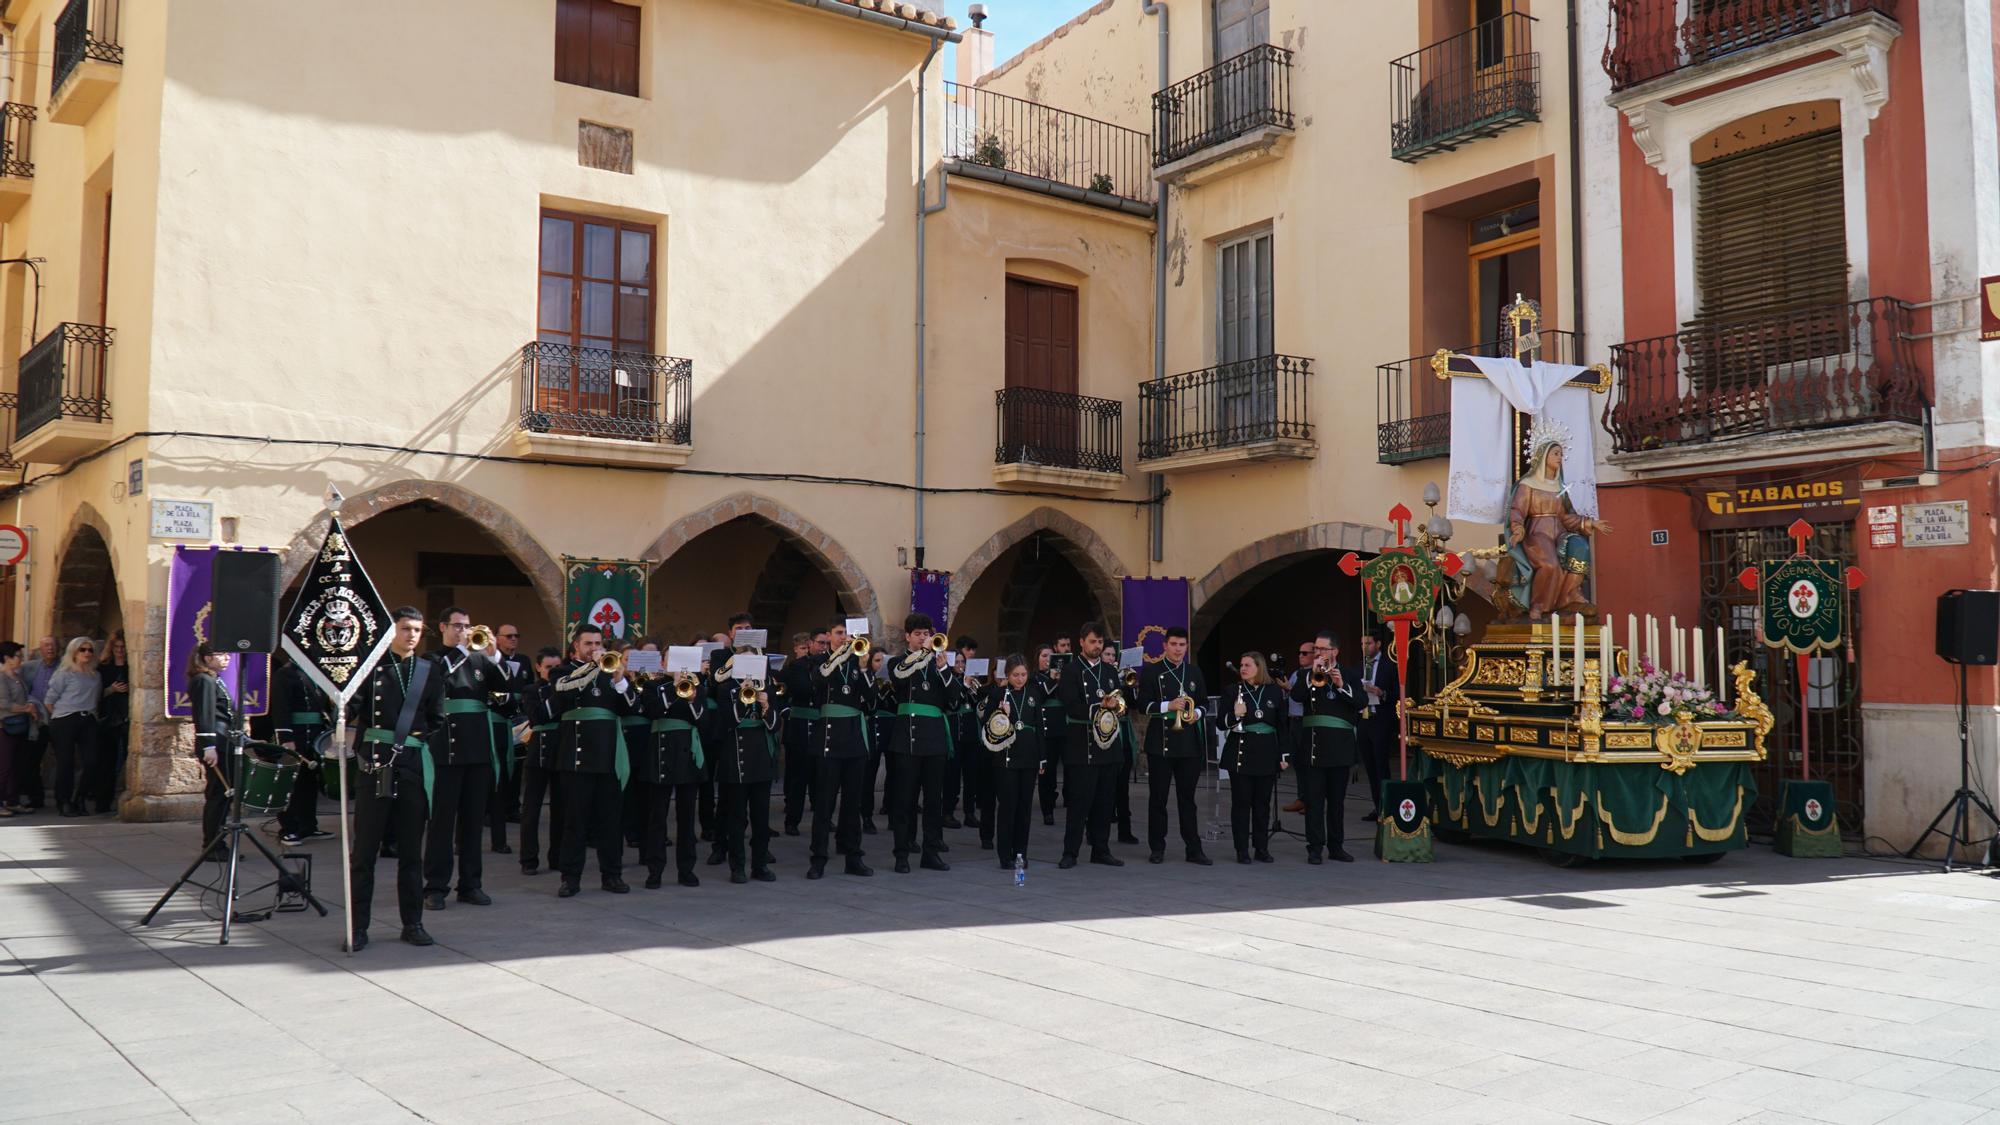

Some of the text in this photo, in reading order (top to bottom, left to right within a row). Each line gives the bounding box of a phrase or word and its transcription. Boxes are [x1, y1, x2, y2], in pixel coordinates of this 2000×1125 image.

[1737, 481, 1843, 503] TABACOS
[1655, 533, 1665, 542] 13
[1926, 533, 1935, 541] LA
[1937, 532, 1952, 540] VILA
[1769, 566, 1805, 591] VIRGEN
[1806, 566, 1820, 578] DE
[1768, 595, 1838, 636] ANGUSTIAS
